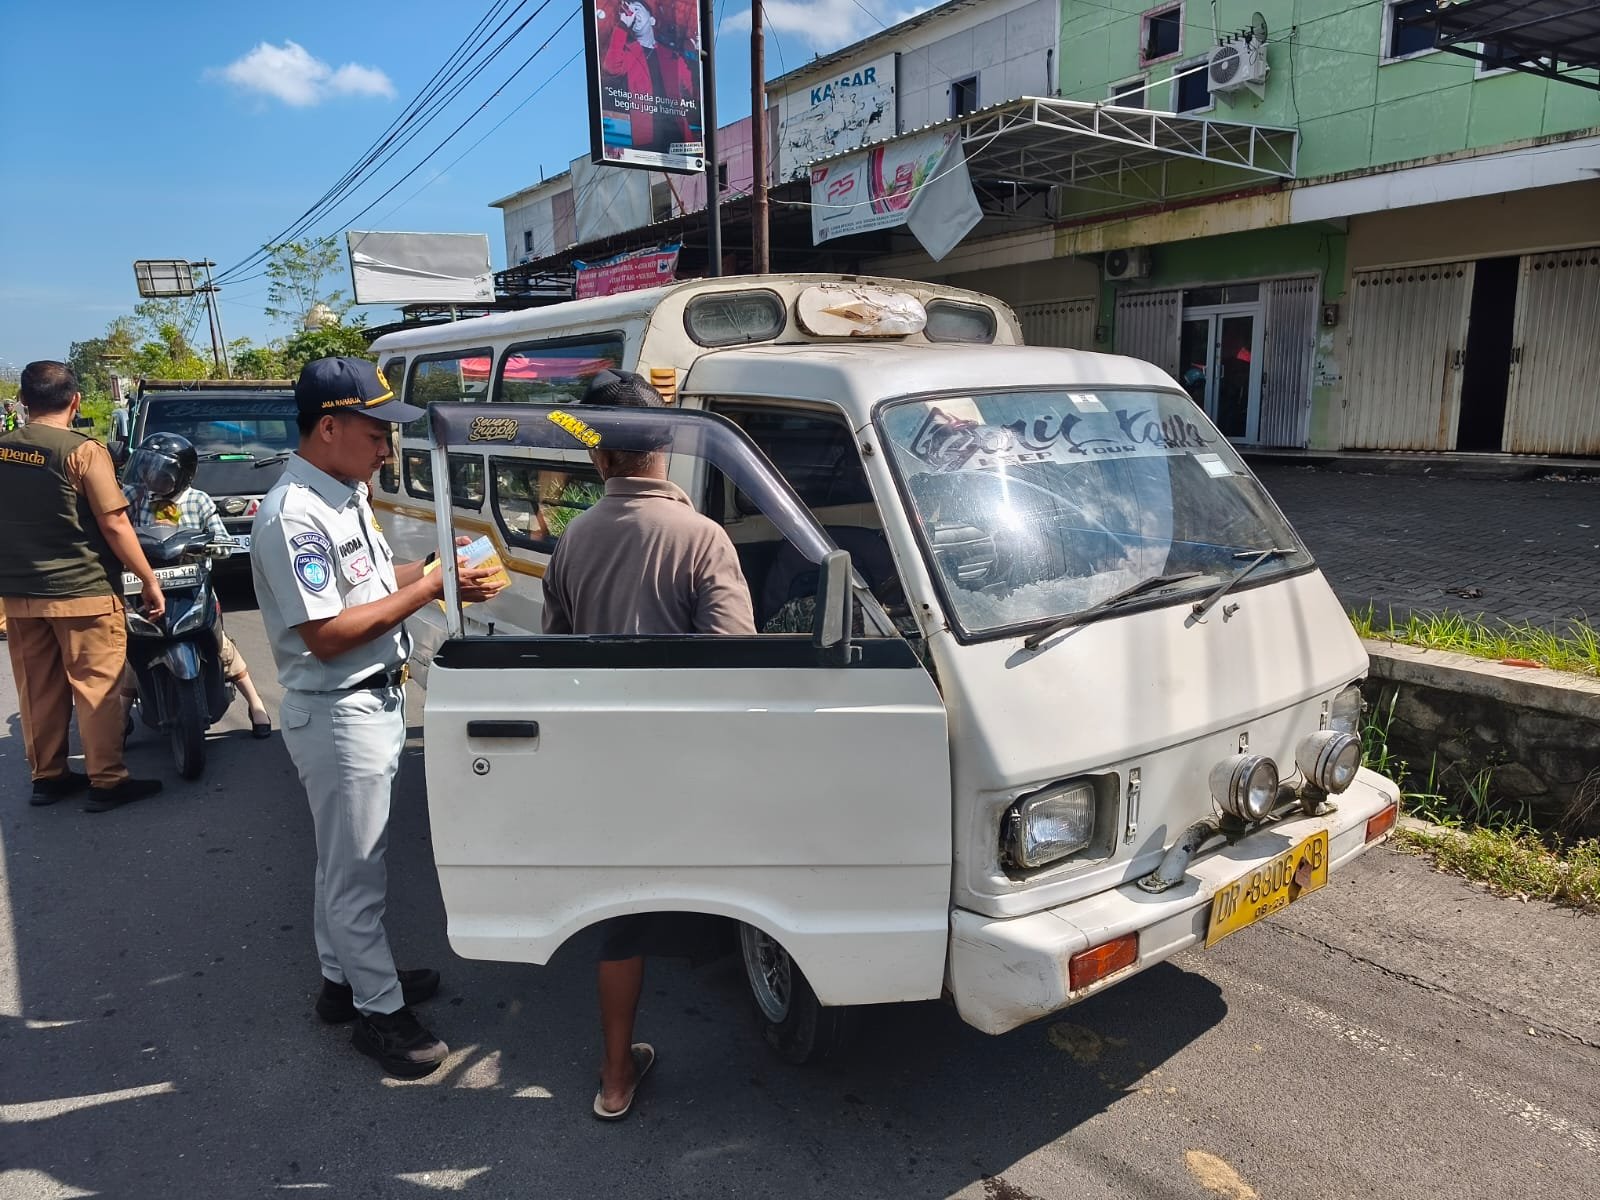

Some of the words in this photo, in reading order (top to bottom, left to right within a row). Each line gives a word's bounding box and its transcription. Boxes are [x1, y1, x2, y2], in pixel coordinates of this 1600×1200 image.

[614, 98, 640, 111] begitu
[641, 102, 658, 114] juga
[634, 92, 653, 102] nada
[655, 96, 679, 107] punya
[680, 99, 697, 109] Arti,
[321, 400, 335, 409] JASA
[473, 416, 518, 430] Seven
[469, 425, 518, 442] Supply
[1216, 882, 1241, 925] DR
[1249, 854, 1294, 904] 8806
